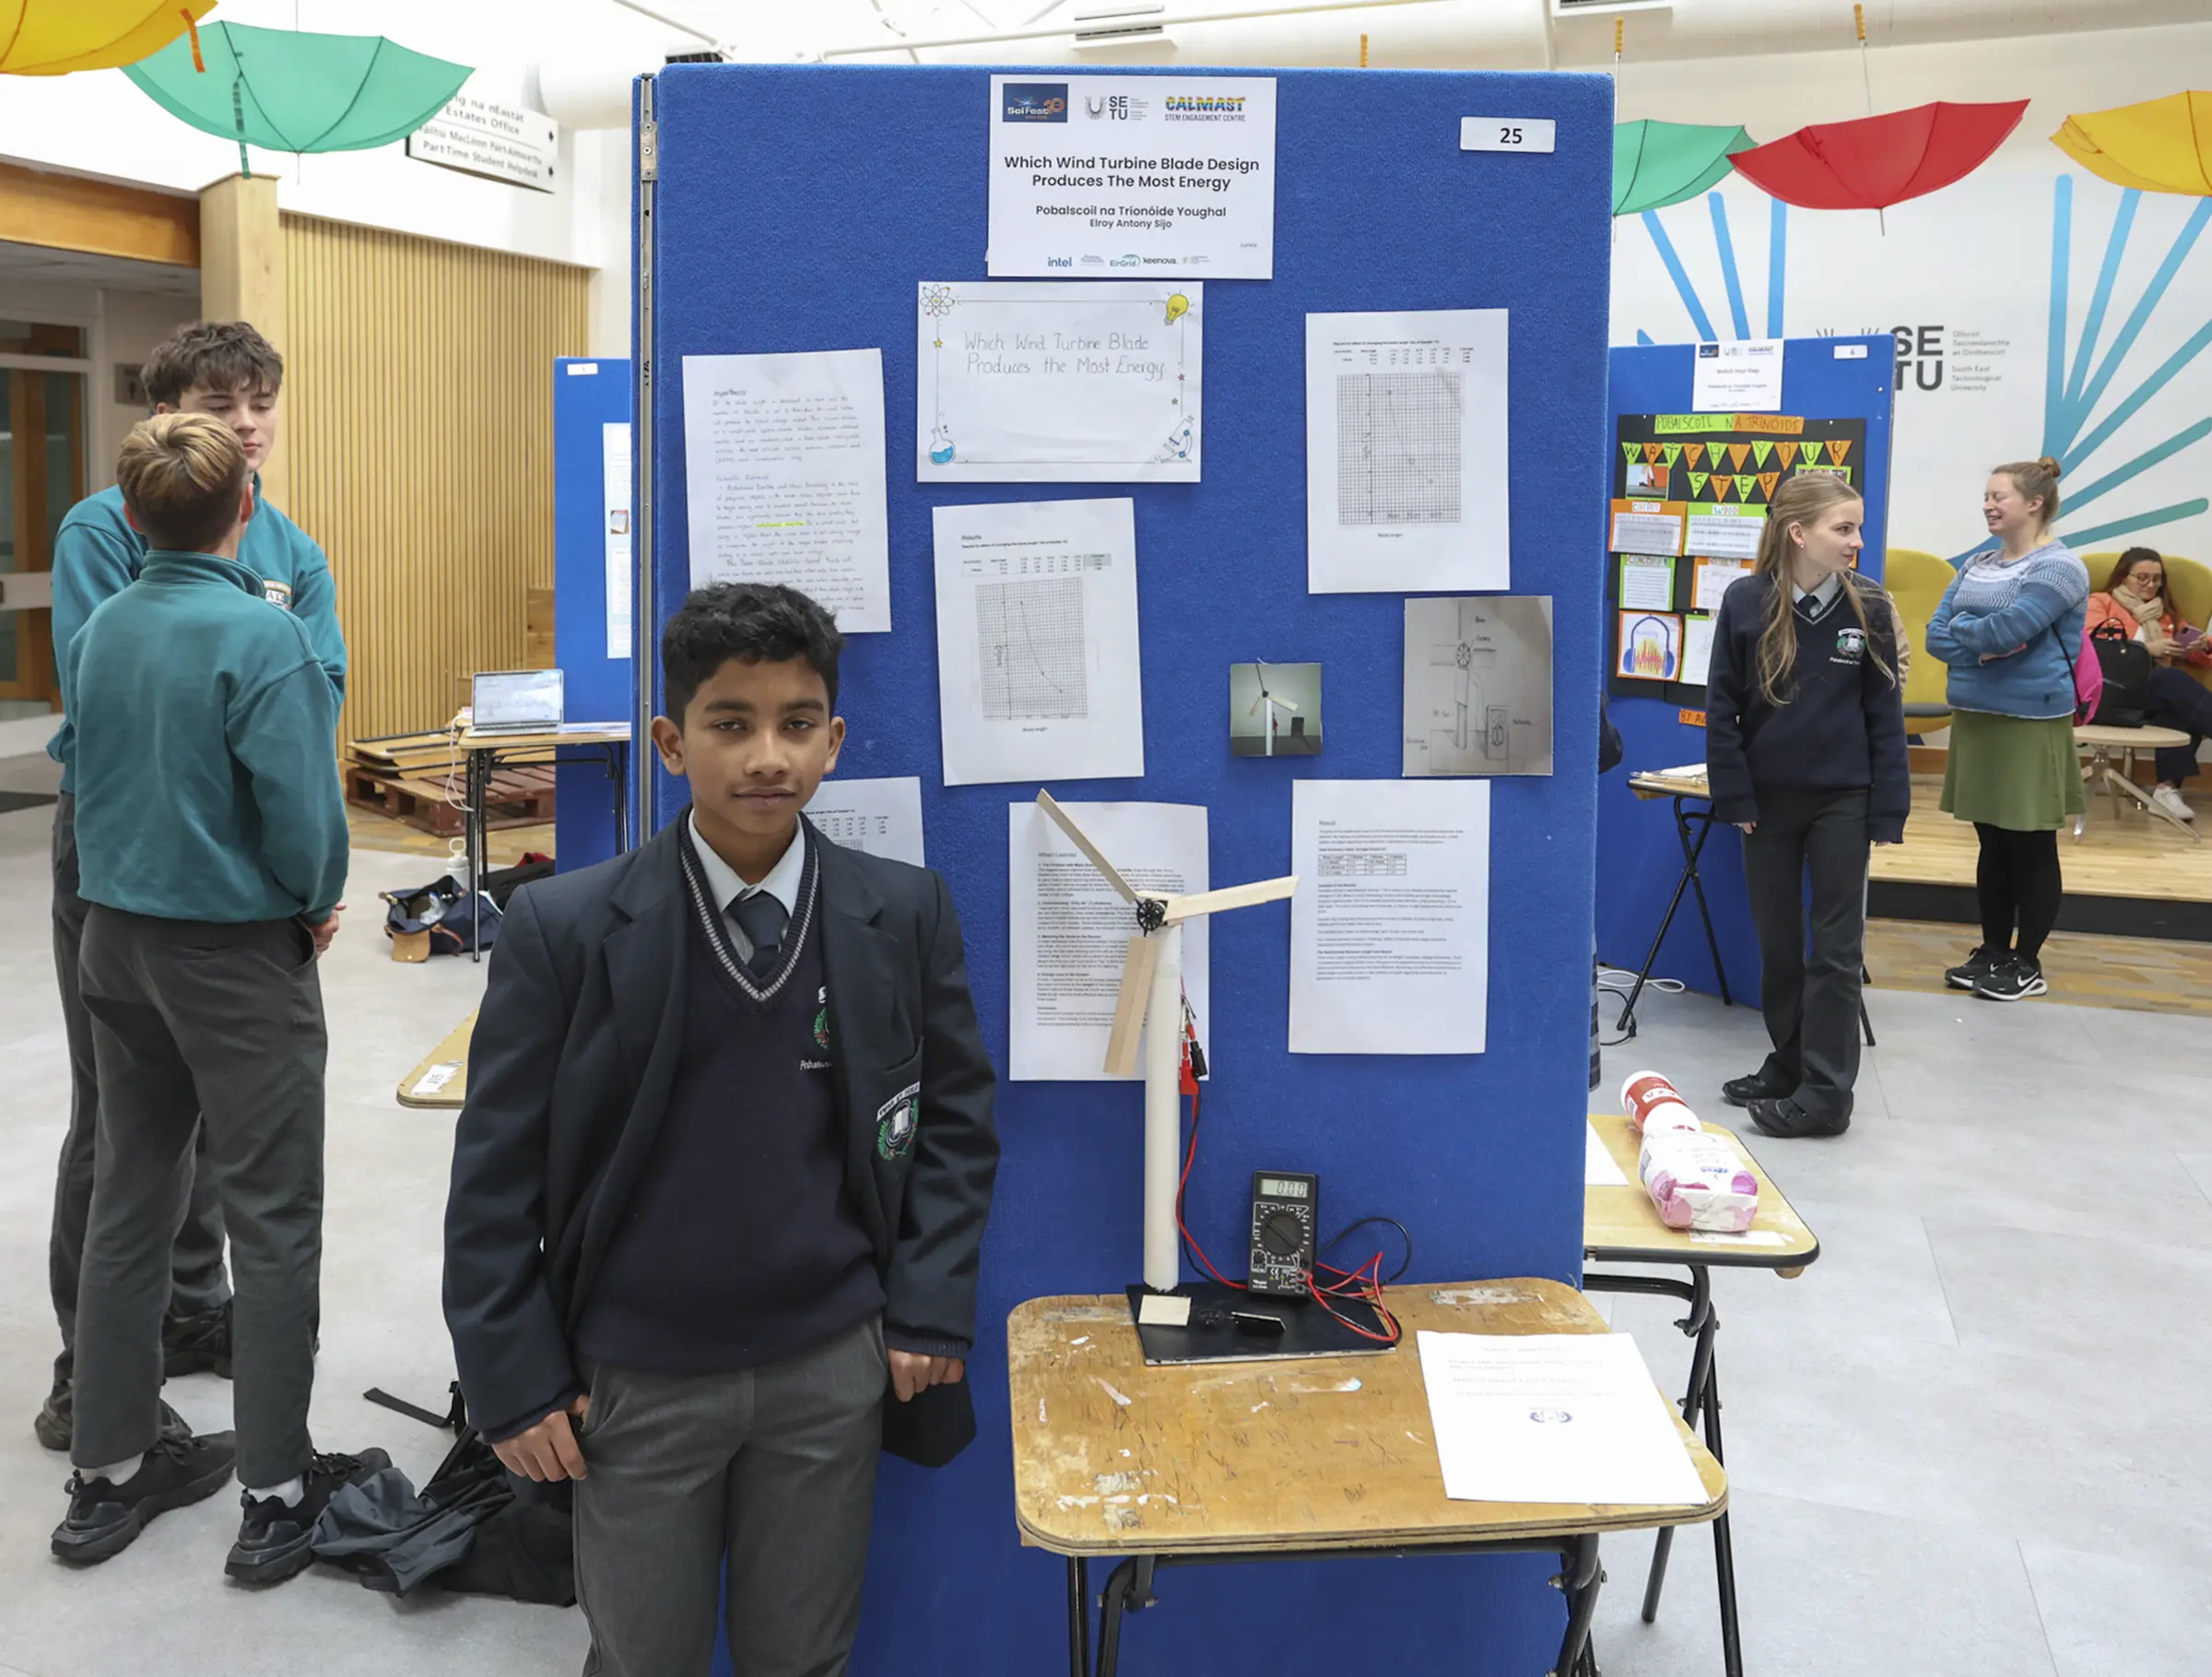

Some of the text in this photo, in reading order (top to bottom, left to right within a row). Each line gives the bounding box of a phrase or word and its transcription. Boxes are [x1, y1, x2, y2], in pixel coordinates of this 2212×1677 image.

[1109, 96, 1128, 108] SE
[1165, 96, 1246, 112] CALMAST
[446, 105, 520, 136] Estates Office
[1109, 109, 1127, 120] TU
[1500, 127, 1523, 144] 25
[472, 151, 505, 170] Student
[1005, 156, 1259, 174] Which Wind Turbine Blade Design
[1032, 174, 1230, 192] Produces The Most Energy
[1036, 206, 1097, 216] Pobalscoil
[1177, 207, 1227, 219] Youghal
[1089, 218, 1172, 230] Elroy Antony Sijo
[1048, 256, 1072, 267] intel
[964, 332, 1149, 351] Which Wind Turbine Blade
[1890, 325, 1944, 357] SE
[967, 352, 1030, 374] Produces
[1043, 357, 1066, 373] the
[1077, 357, 1111, 373] Most
[1896, 360, 1943, 391] TU
